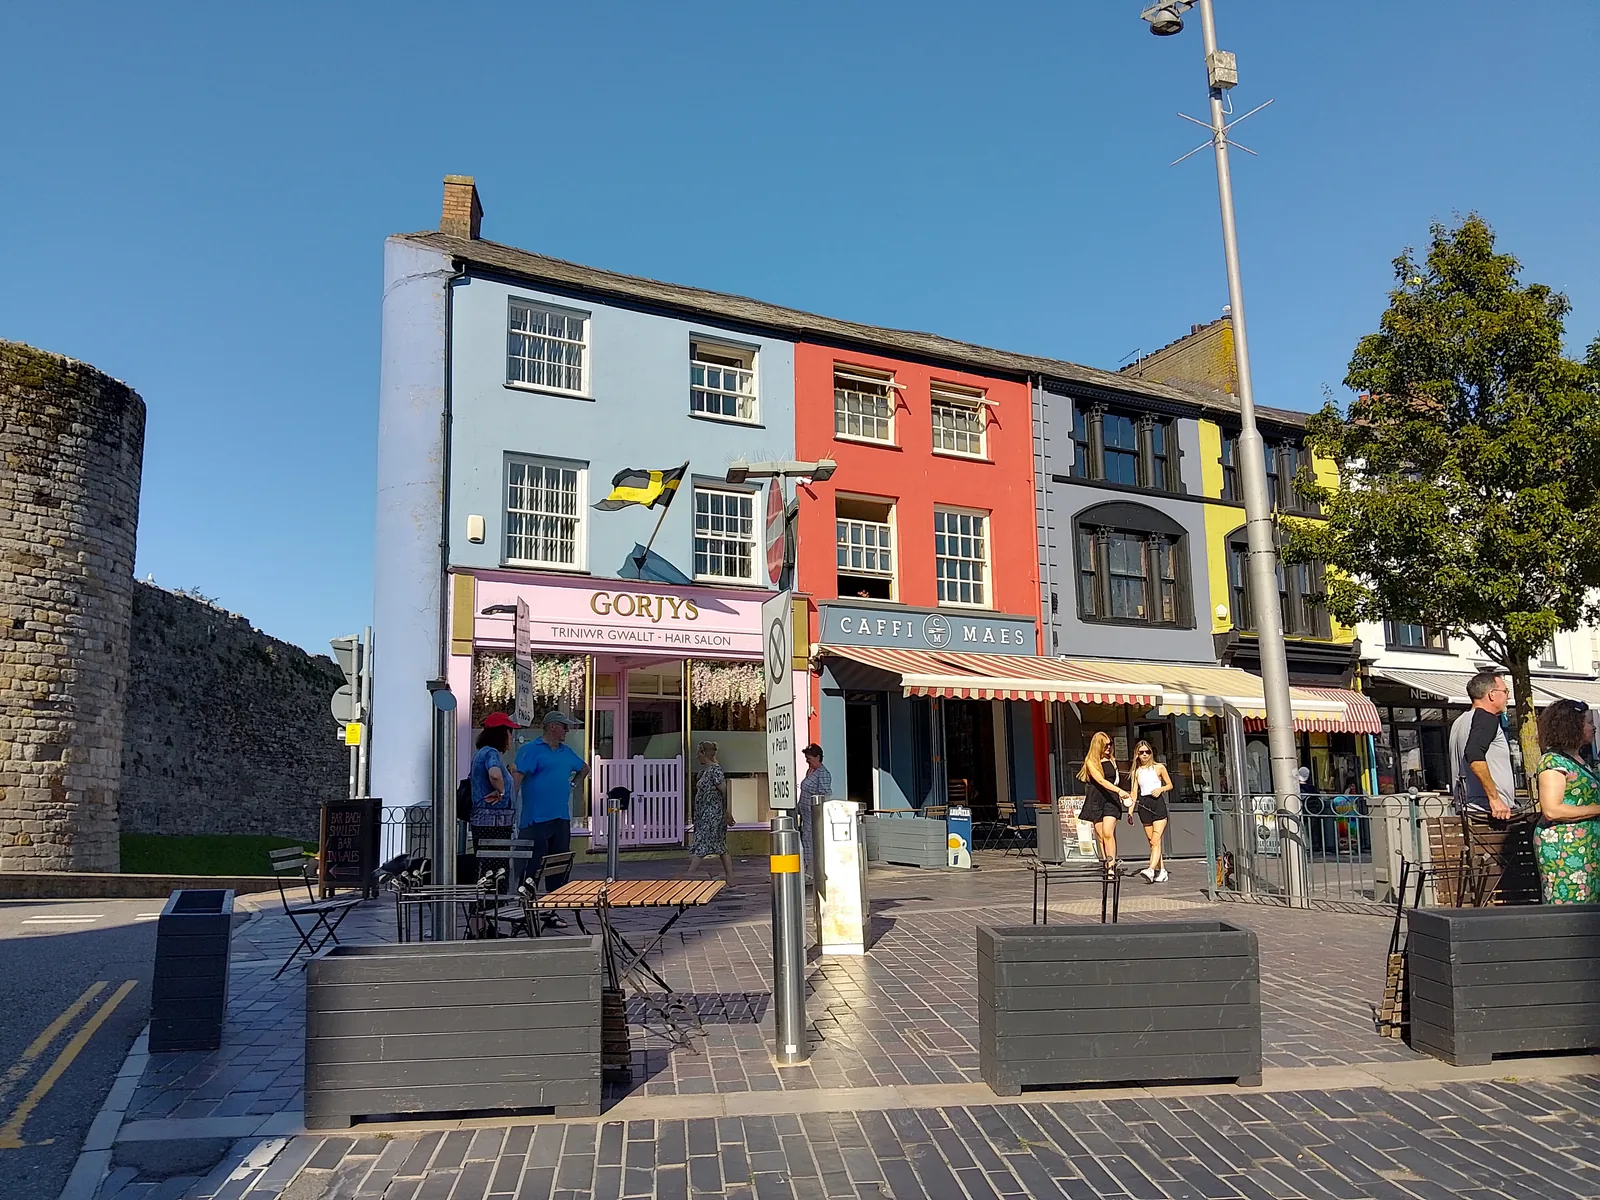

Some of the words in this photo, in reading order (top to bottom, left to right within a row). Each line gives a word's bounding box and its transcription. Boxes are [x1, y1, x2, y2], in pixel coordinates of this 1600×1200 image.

[590, 592, 699, 623] GORJYS
[551, 626, 604, 640] TRINIWR
[607, 629, 655, 642] GWALLT
[665, 633, 691, 644] HAIR
[694, 634, 731, 646] SALON
[840, 617, 913, 638] CAFFI
[963, 625, 1024, 645] MAES
[768, 712, 791, 734] DIWEDD
[776, 736, 788, 752] Parth
[775, 763, 786, 776] Zone
[773, 780, 790, 798] ENDS
[331, 812, 344, 824] BAR
[345, 811, 361, 824] BACH
[337, 838, 352, 850] BAR
[326, 850, 337, 863] IN
[338, 850, 360, 862] WALES
